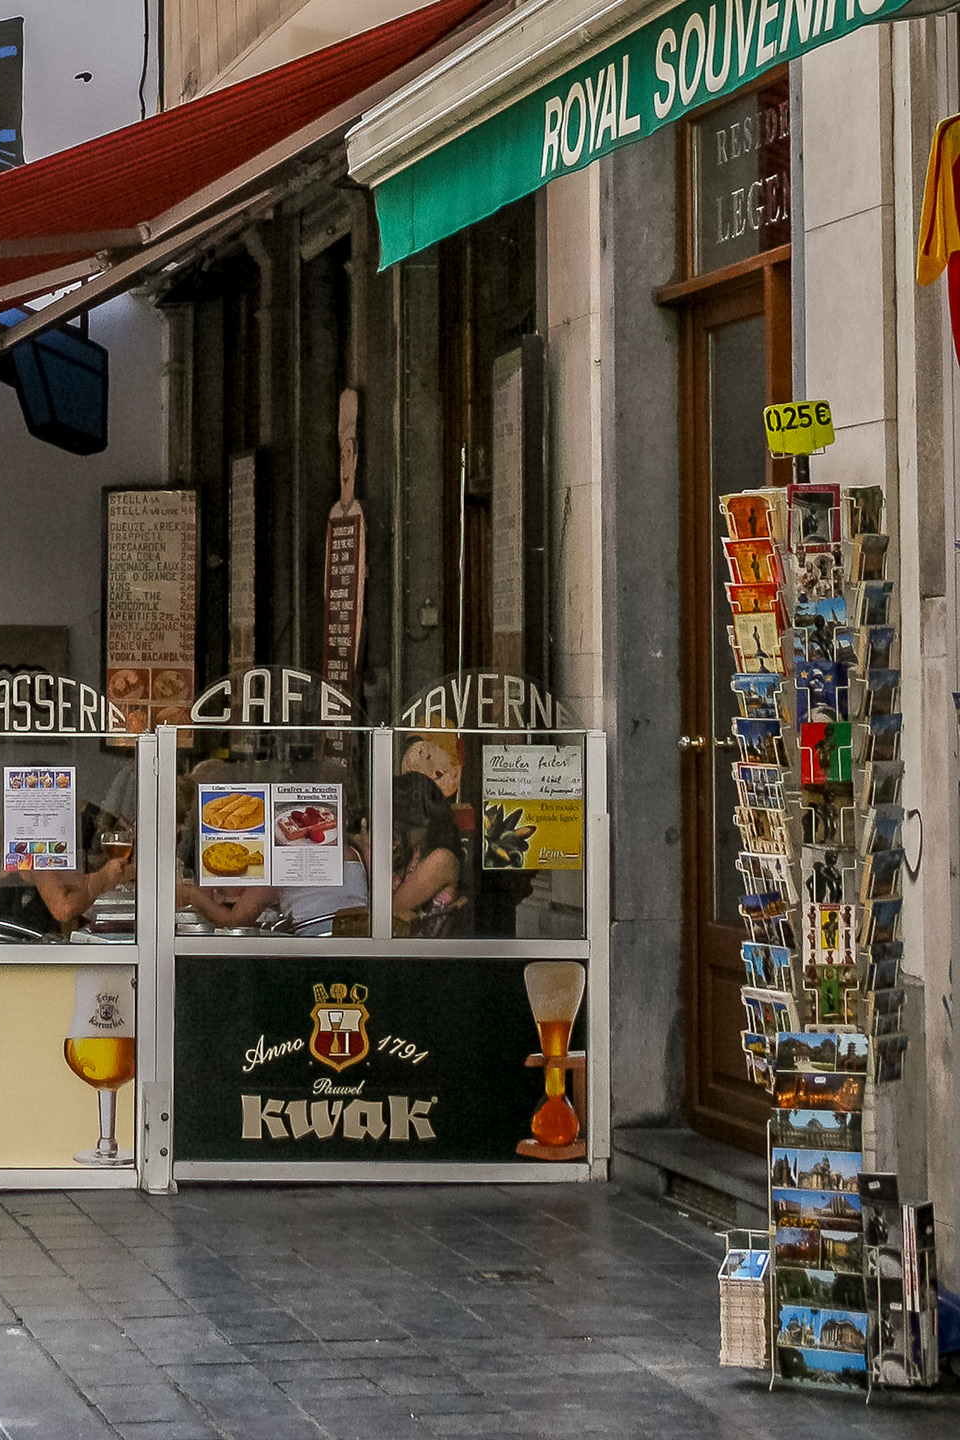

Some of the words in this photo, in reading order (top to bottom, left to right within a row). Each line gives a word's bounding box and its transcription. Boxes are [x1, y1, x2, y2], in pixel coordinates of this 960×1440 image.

[540, 54, 640, 178] ROYAL
[109, 612, 157, 621] APERITIFS
[191, 669, 352, 723] CAFE
[242, 1034, 305, 1073] Anno
[377, 1034, 429, 1065] 1791
